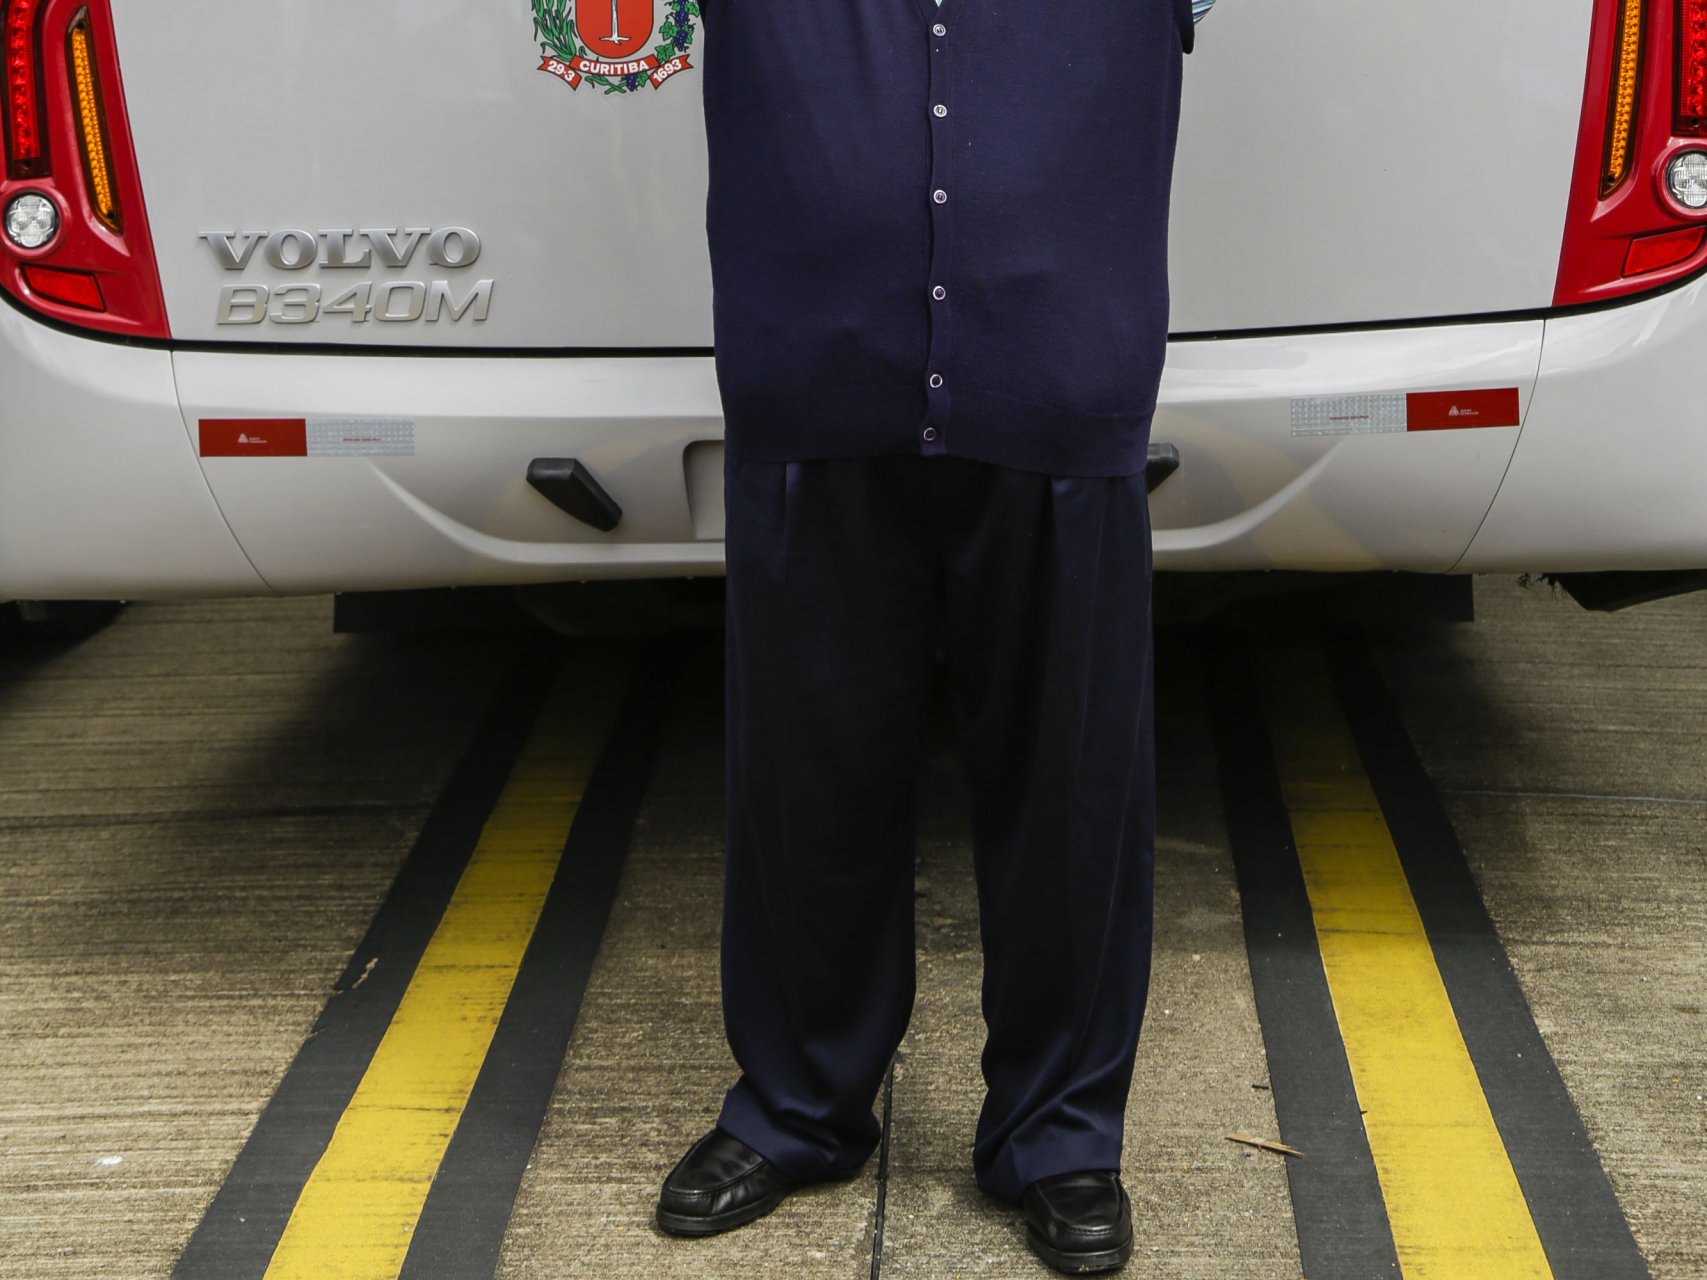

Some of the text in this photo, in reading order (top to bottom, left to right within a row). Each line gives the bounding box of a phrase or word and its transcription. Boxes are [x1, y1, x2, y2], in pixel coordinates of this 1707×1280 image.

[579, 59, 649, 75] CURITIBA
[652, 58, 682, 83] 1693
[198, 226, 481, 270] VOLVO
[216, 279, 495, 325] B340M
